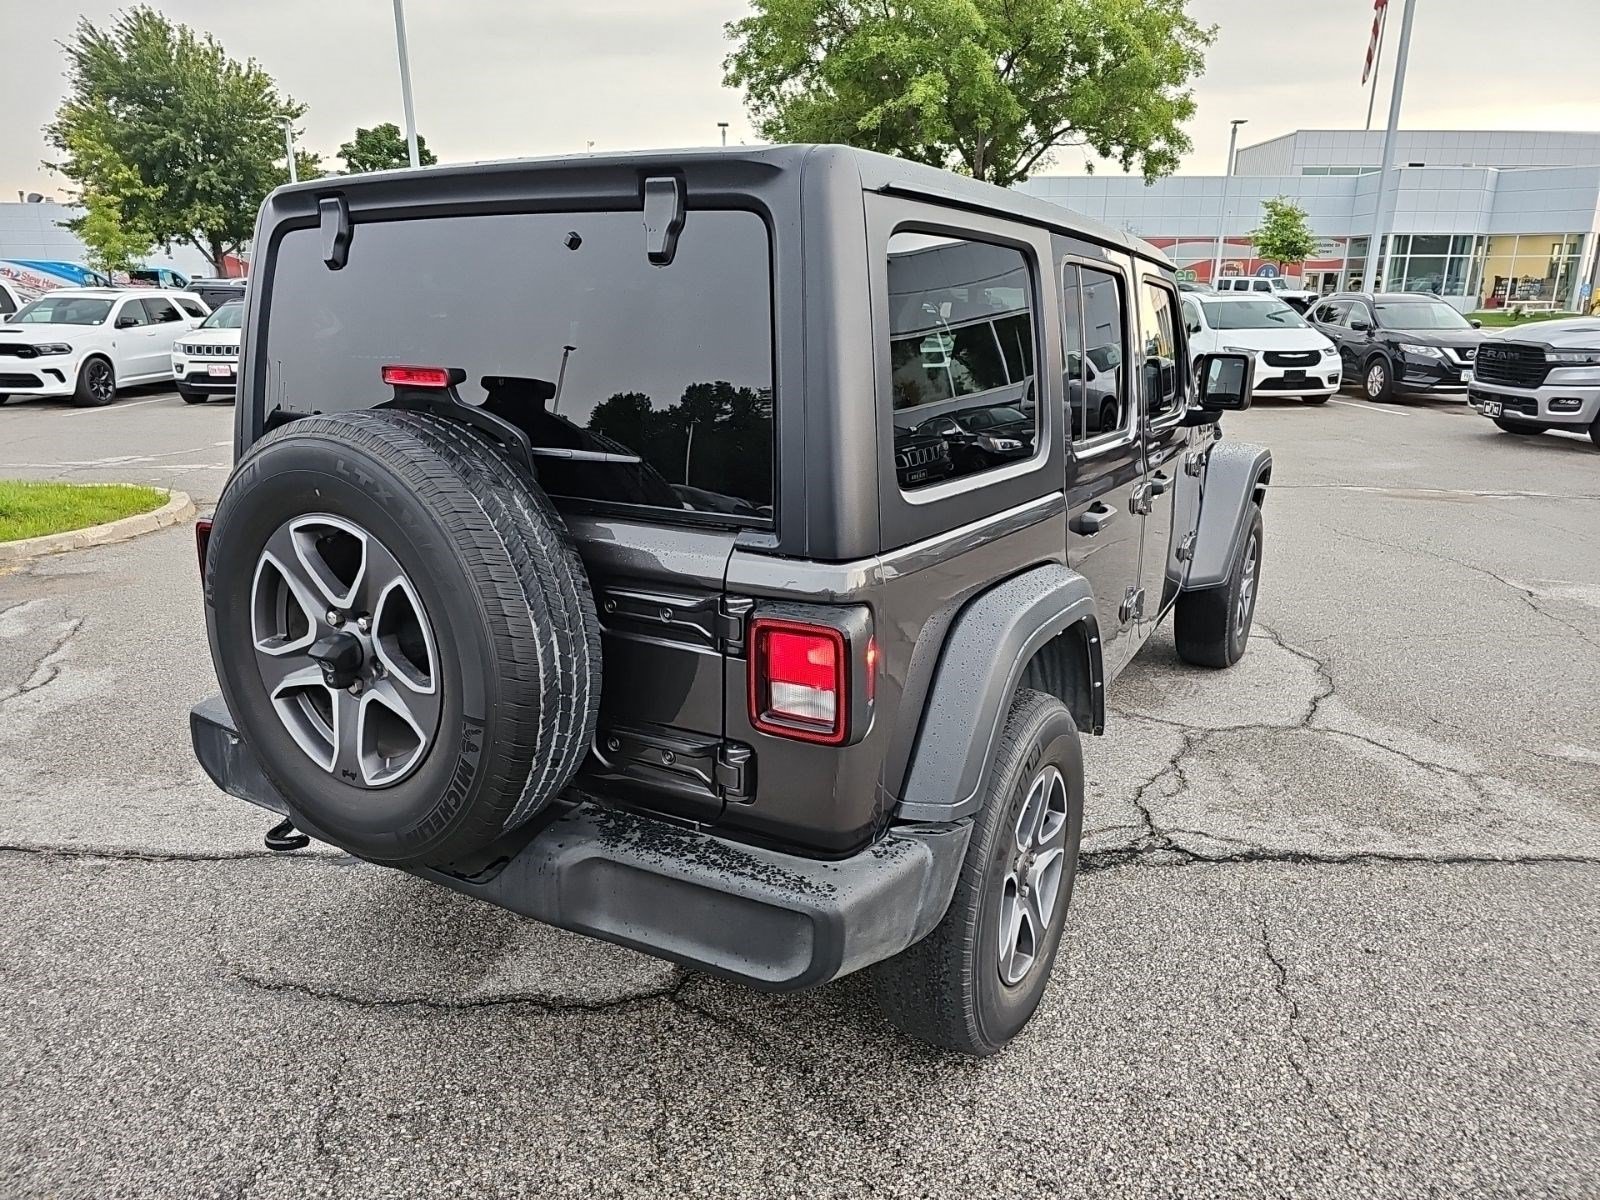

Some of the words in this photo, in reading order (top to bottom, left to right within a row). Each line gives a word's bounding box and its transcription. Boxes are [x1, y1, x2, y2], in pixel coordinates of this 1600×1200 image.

[21, 271, 42, 285] Stew
[1486, 350, 1520, 360] RAM
[336, 459, 396, 505] LTX
[406, 757, 476, 841] MICHELIN
